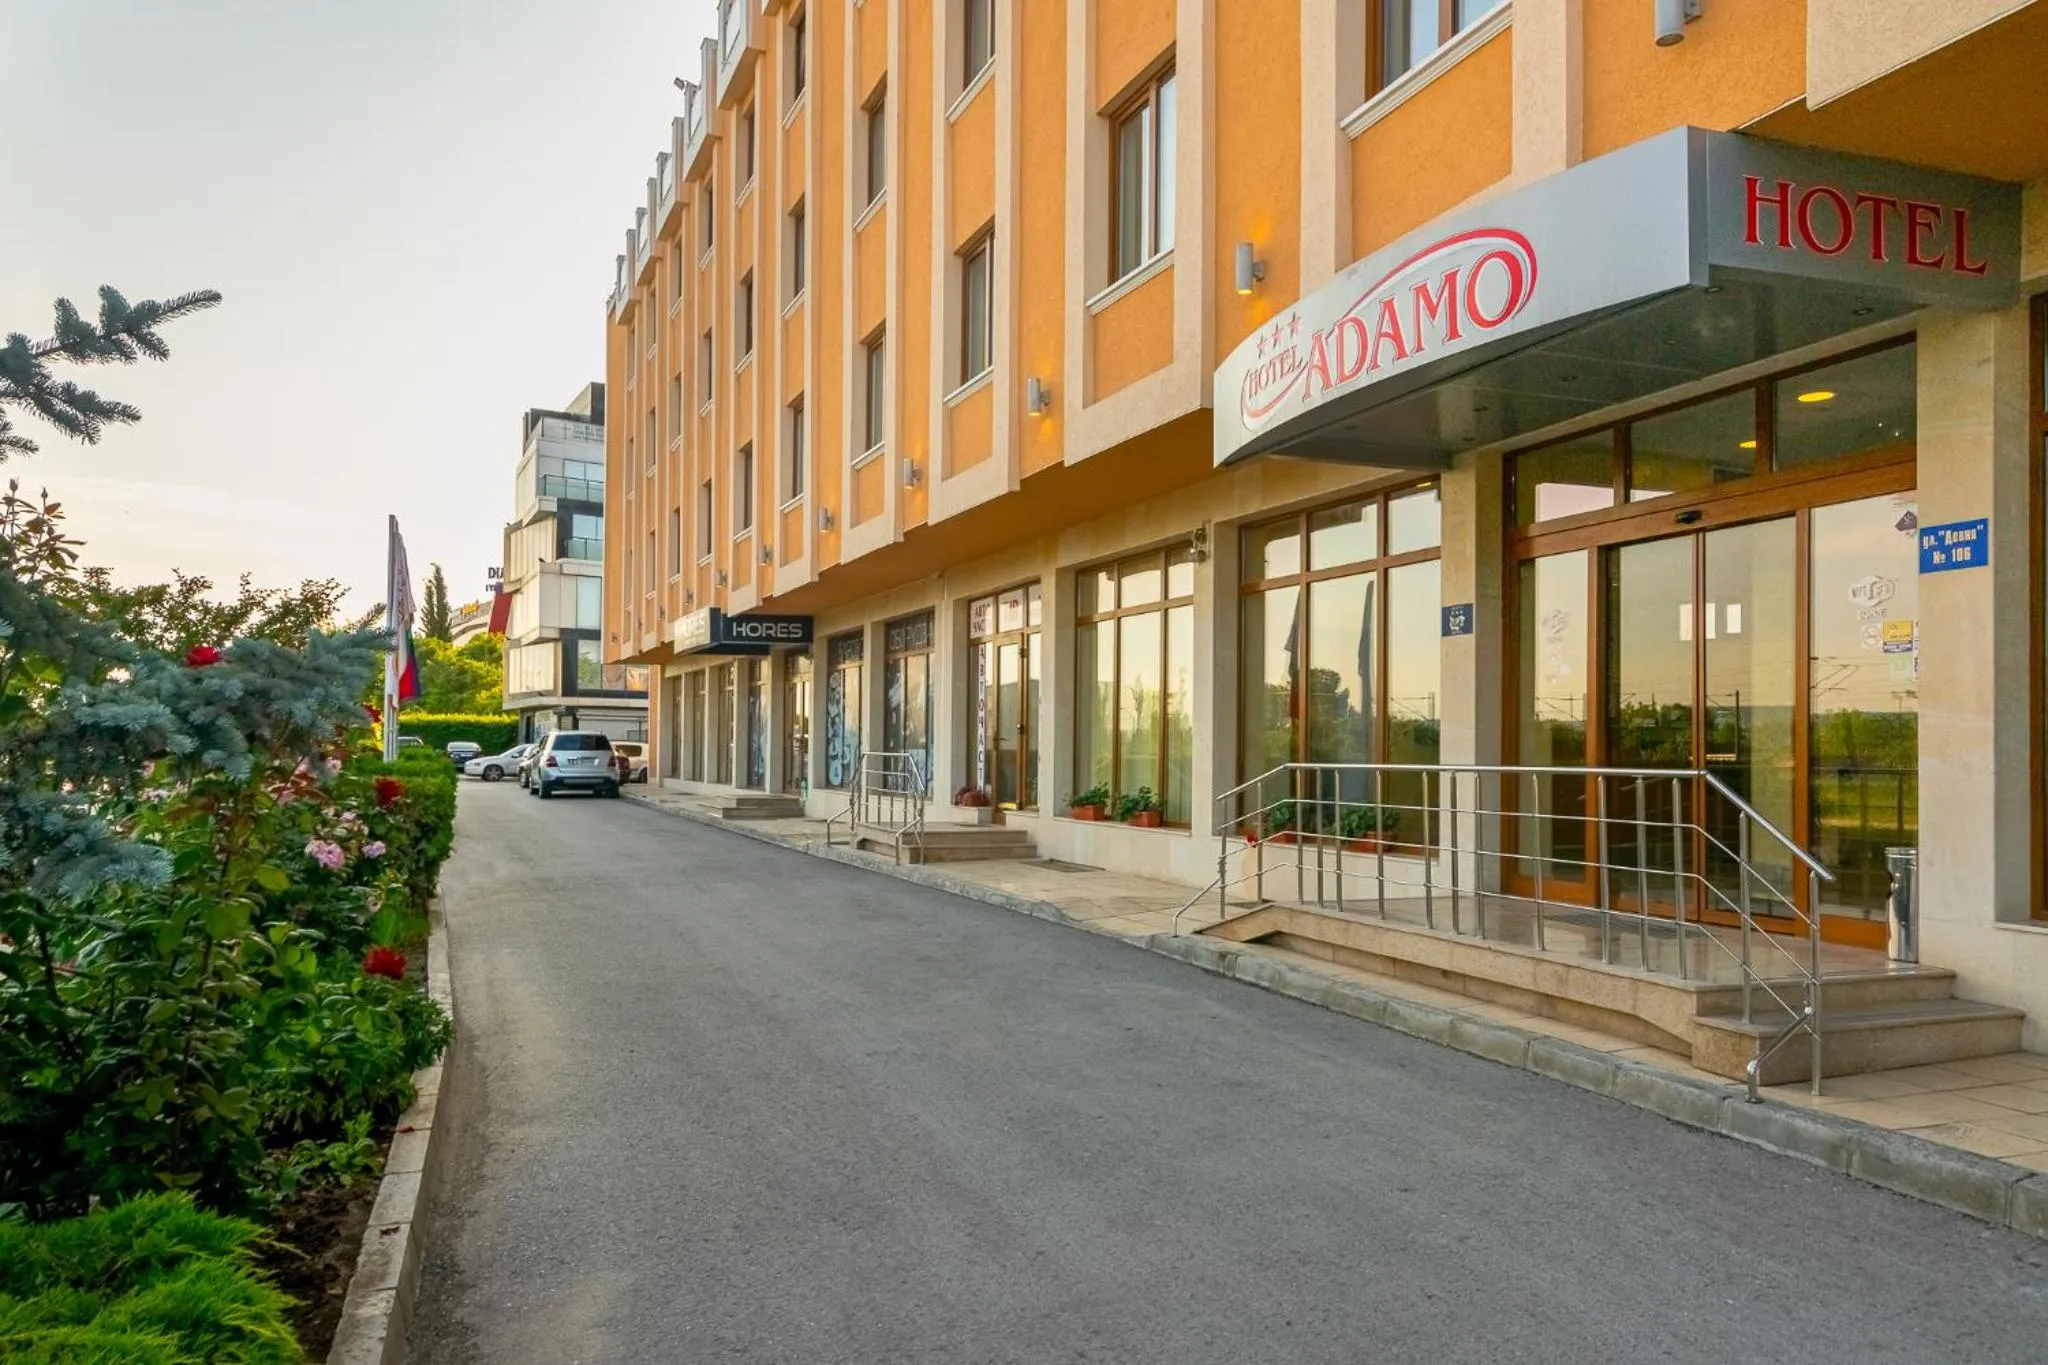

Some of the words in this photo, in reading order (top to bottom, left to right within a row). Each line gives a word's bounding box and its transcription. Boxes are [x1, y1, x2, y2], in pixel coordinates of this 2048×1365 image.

[1742, 175, 1989, 276] HOTEL
[1248, 344, 1303, 399] HOTEL
[1302, 249, 1524, 402] ADAMO
[732, 622, 803, 638] HORES
